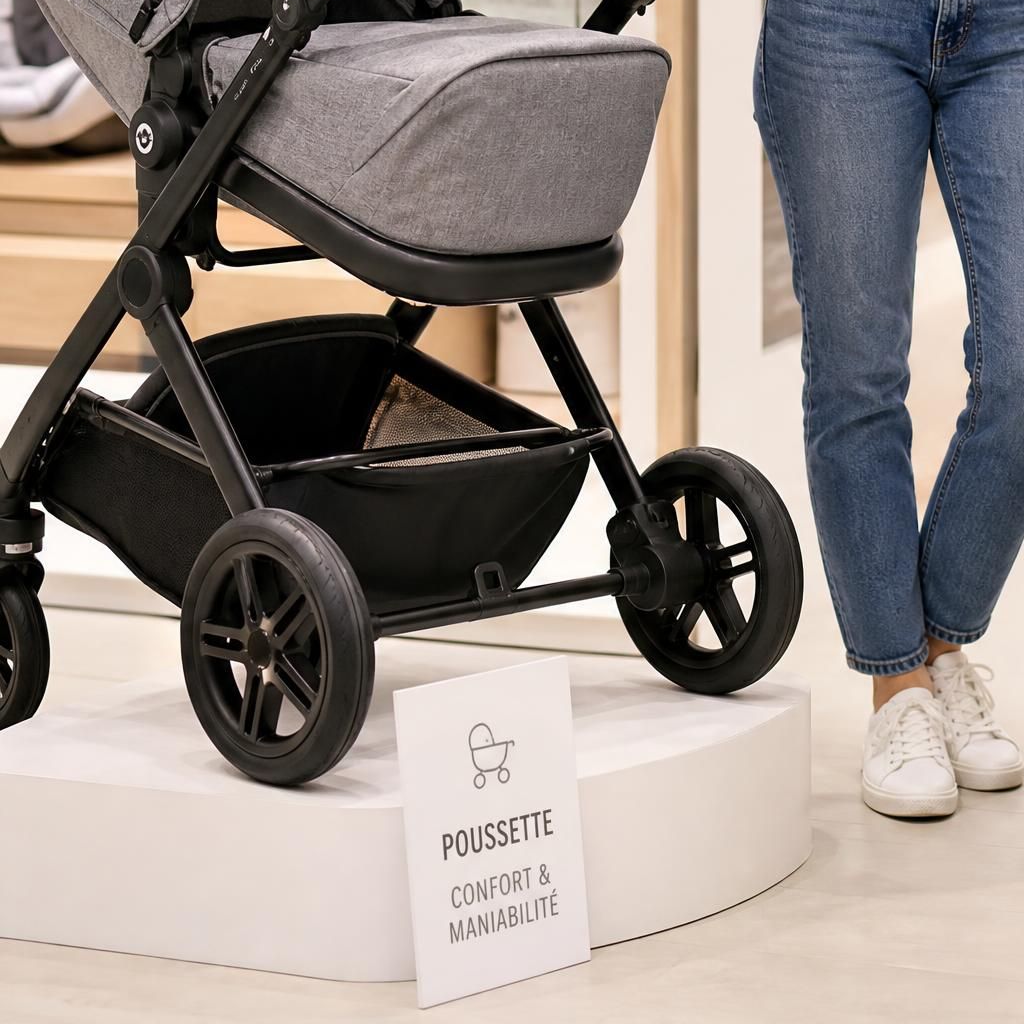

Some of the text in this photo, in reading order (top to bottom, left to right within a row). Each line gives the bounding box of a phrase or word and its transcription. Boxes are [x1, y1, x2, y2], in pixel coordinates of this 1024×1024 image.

[443, 809, 553, 860] POUSSETTE
[451, 864, 550, 908] CONFORT &
[450, 888, 558, 944] MANIABILITÉ
